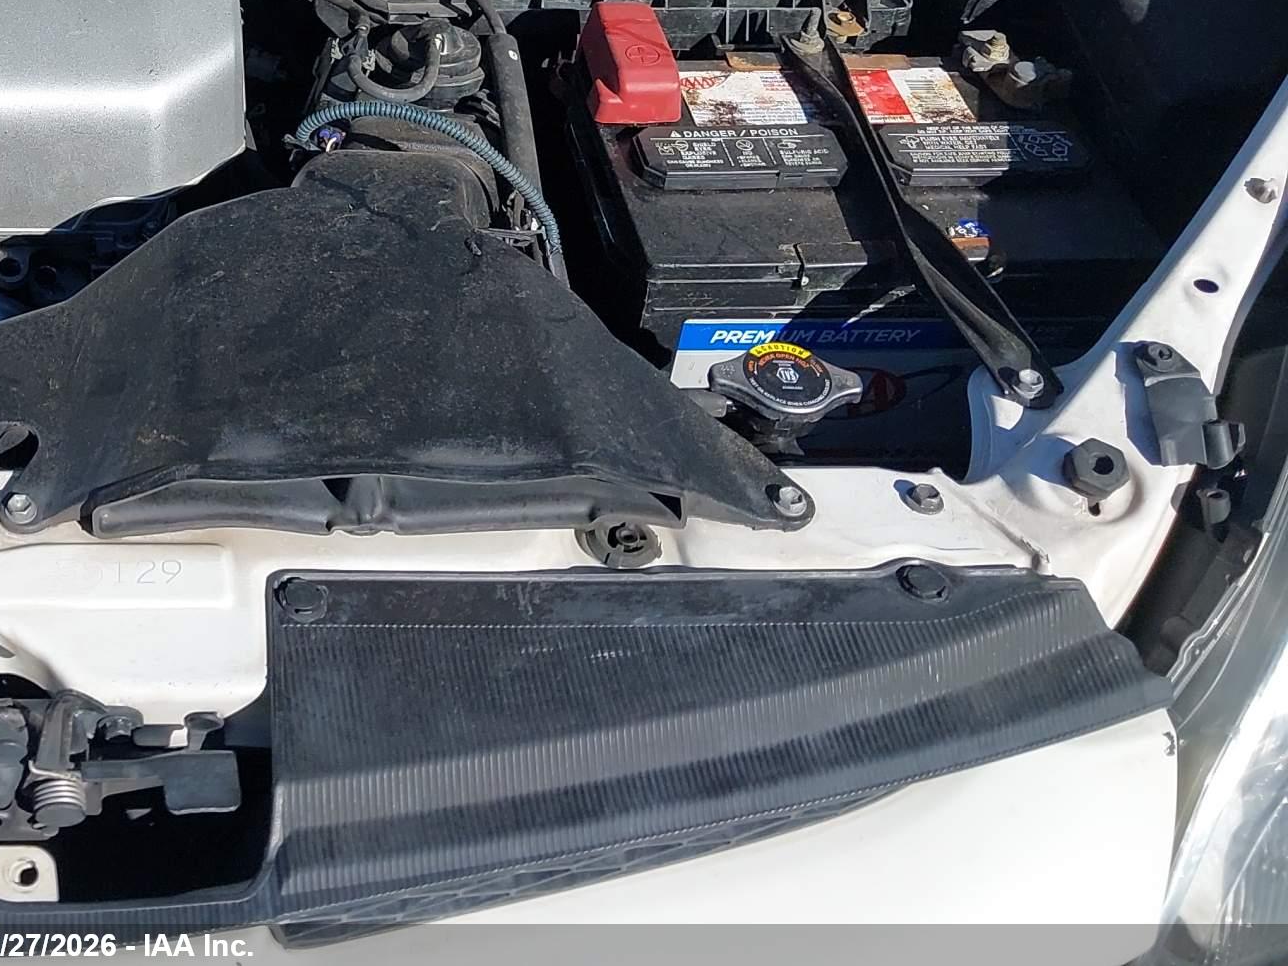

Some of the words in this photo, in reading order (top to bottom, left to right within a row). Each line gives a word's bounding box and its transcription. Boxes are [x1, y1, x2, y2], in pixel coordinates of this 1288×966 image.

[683, 129, 737, 138] DANGER
[749, 128, 799, 137] POISON
[710, 329, 813, 344] PREMIUM
[816, 329, 920, 343] BATTERY
[775, 353, 795, 361] OPEN
